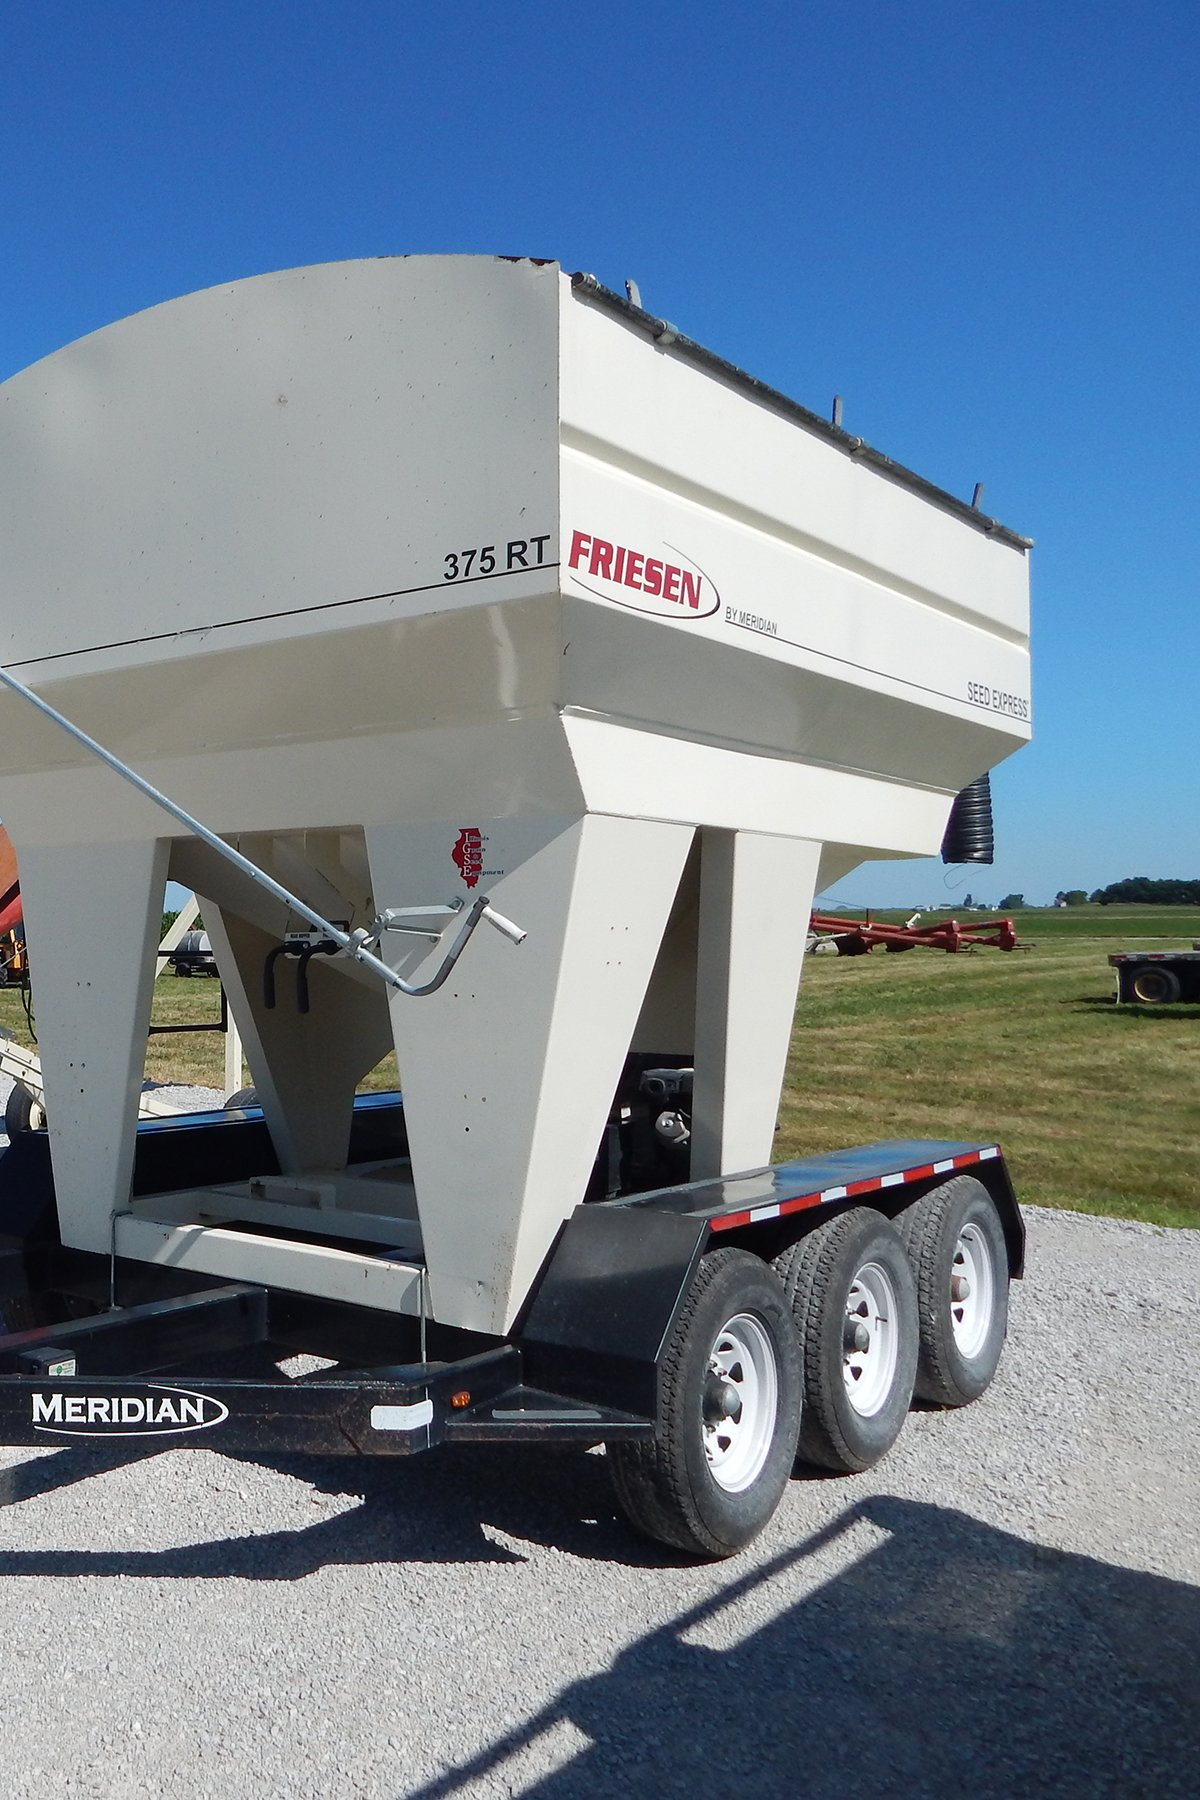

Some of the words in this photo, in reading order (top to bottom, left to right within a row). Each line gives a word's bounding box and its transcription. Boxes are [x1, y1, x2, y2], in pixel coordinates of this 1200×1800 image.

[443, 545, 496, 580] 375
[506, 534, 551, 569] RT
[567, 529, 703, 610] FRIESEN
[725, 606, 739, 621] BY
[739, 611, 778, 636] MERIDIAN
[967, 680, 991, 706] SEED
[992, 689, 1029, 718] EXPRESS
[31, 1393, 205, 1424] MERIDIAN
